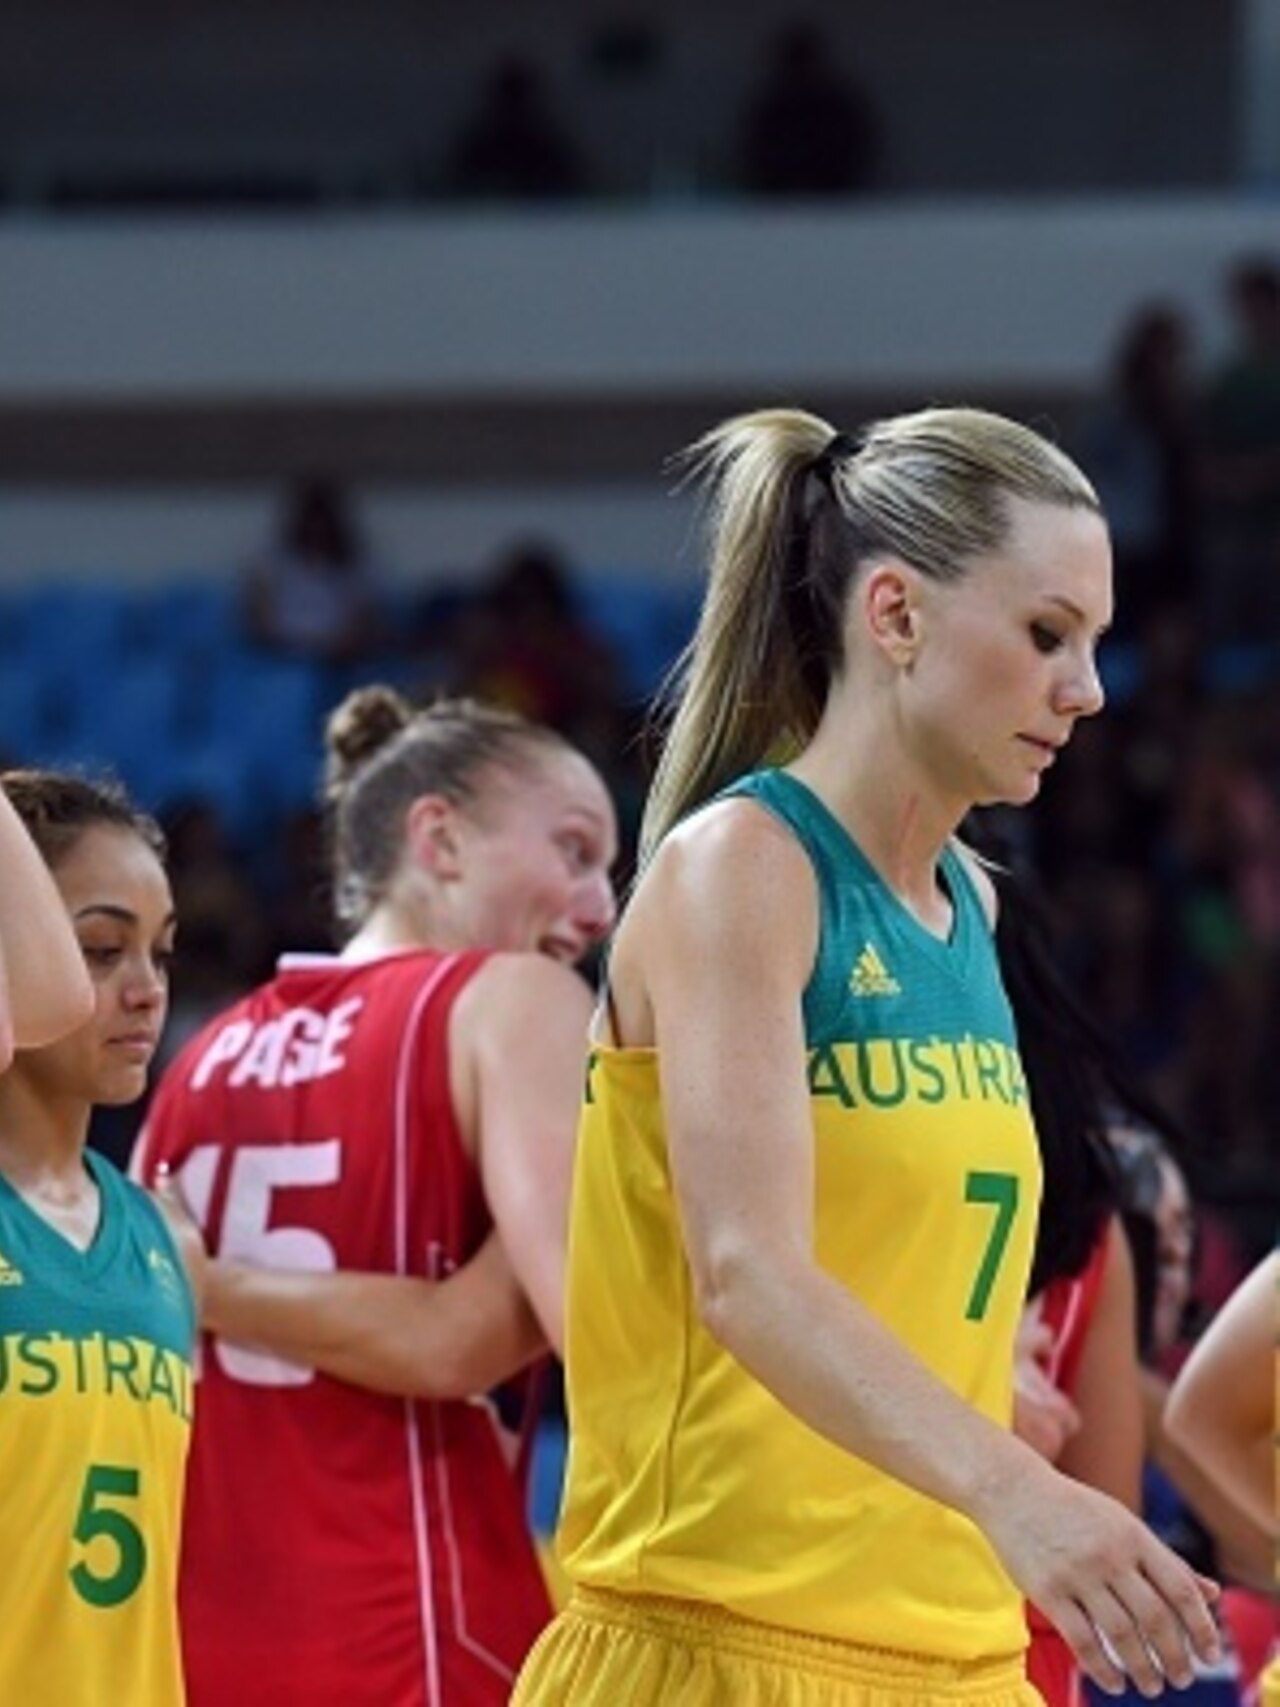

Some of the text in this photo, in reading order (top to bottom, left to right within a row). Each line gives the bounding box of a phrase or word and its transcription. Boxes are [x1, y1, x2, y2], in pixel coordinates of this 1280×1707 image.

[189, 997, 363, 1091] PAGE
[964, 1171, 1019, 1322] 7
[69, 1464, 147, 1609] 5
